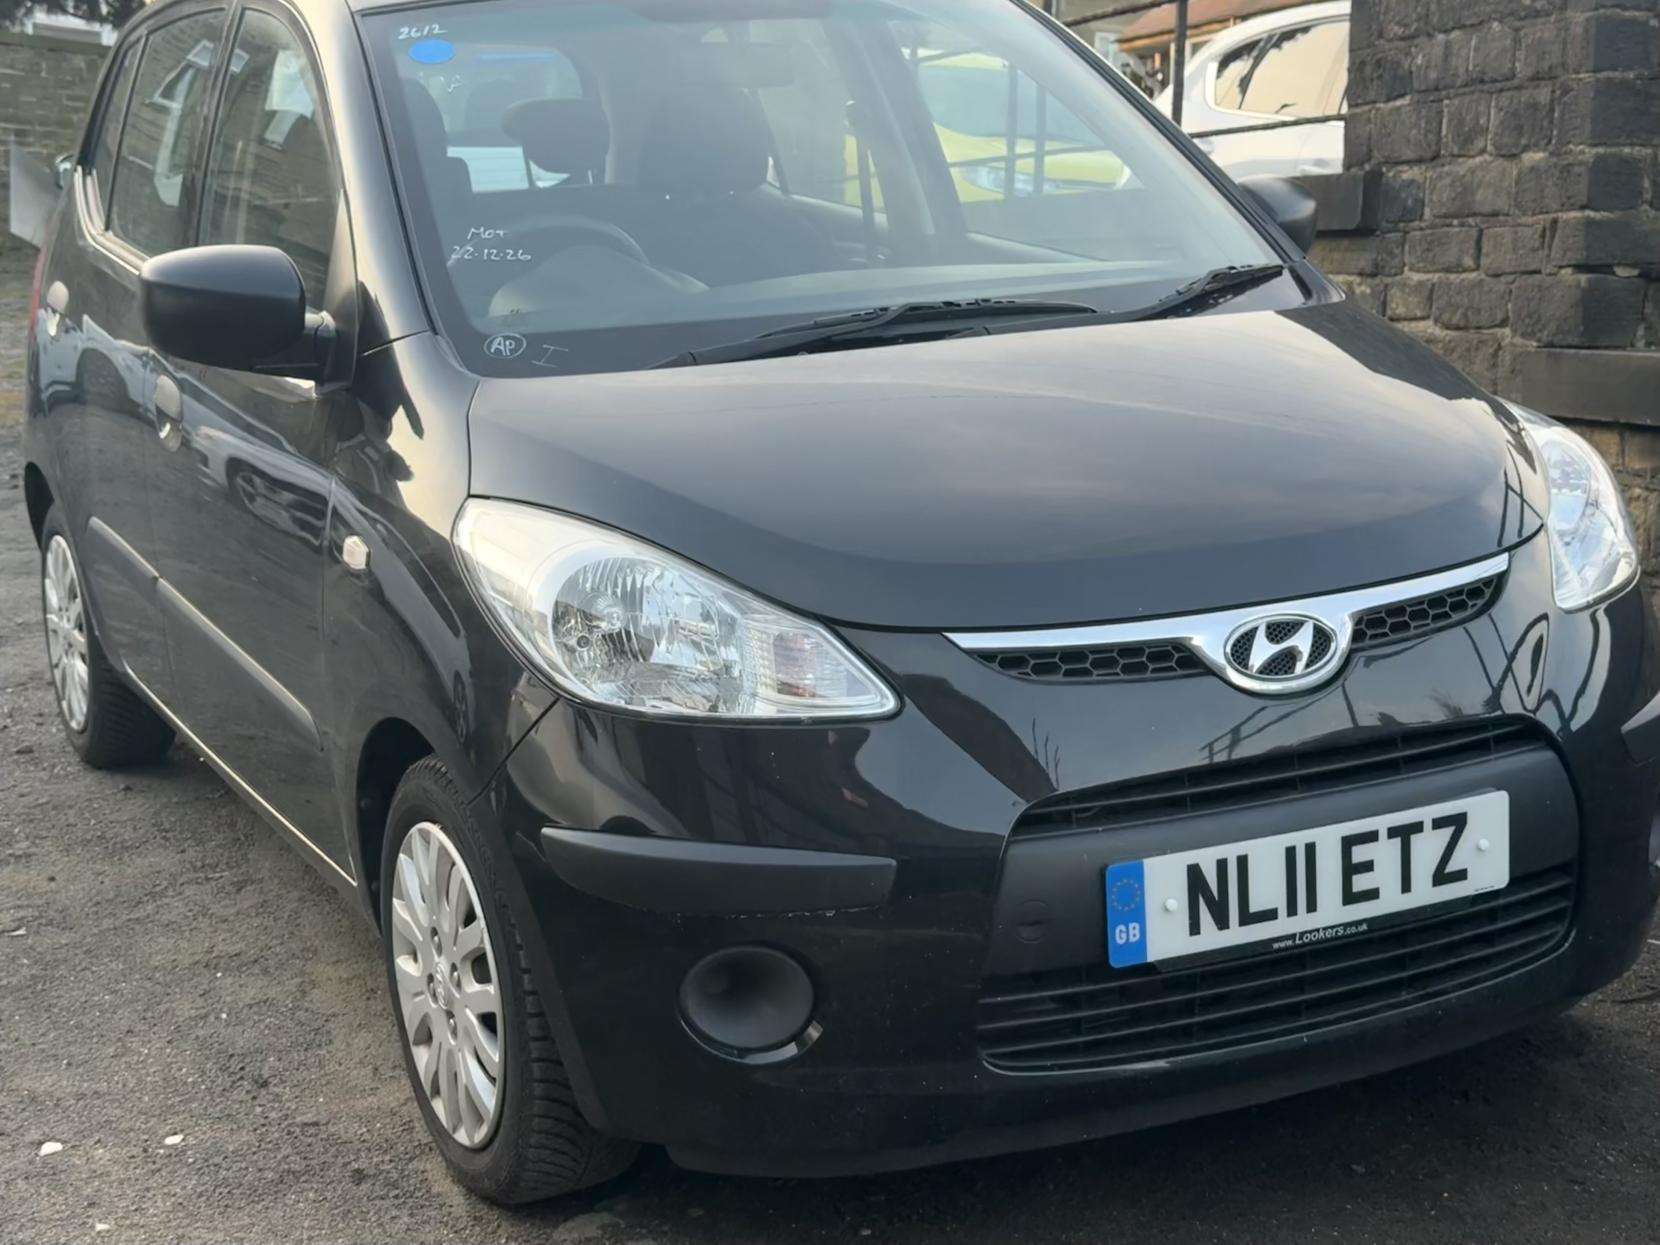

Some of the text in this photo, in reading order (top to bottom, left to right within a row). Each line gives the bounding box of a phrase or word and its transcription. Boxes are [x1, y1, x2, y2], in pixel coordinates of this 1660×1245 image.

[1341, 811, 1468, 907] ETZ
[1115, 922, 1140, 944] GB
[1272, 922, 1368, 949] www.Lookers.co.uk
